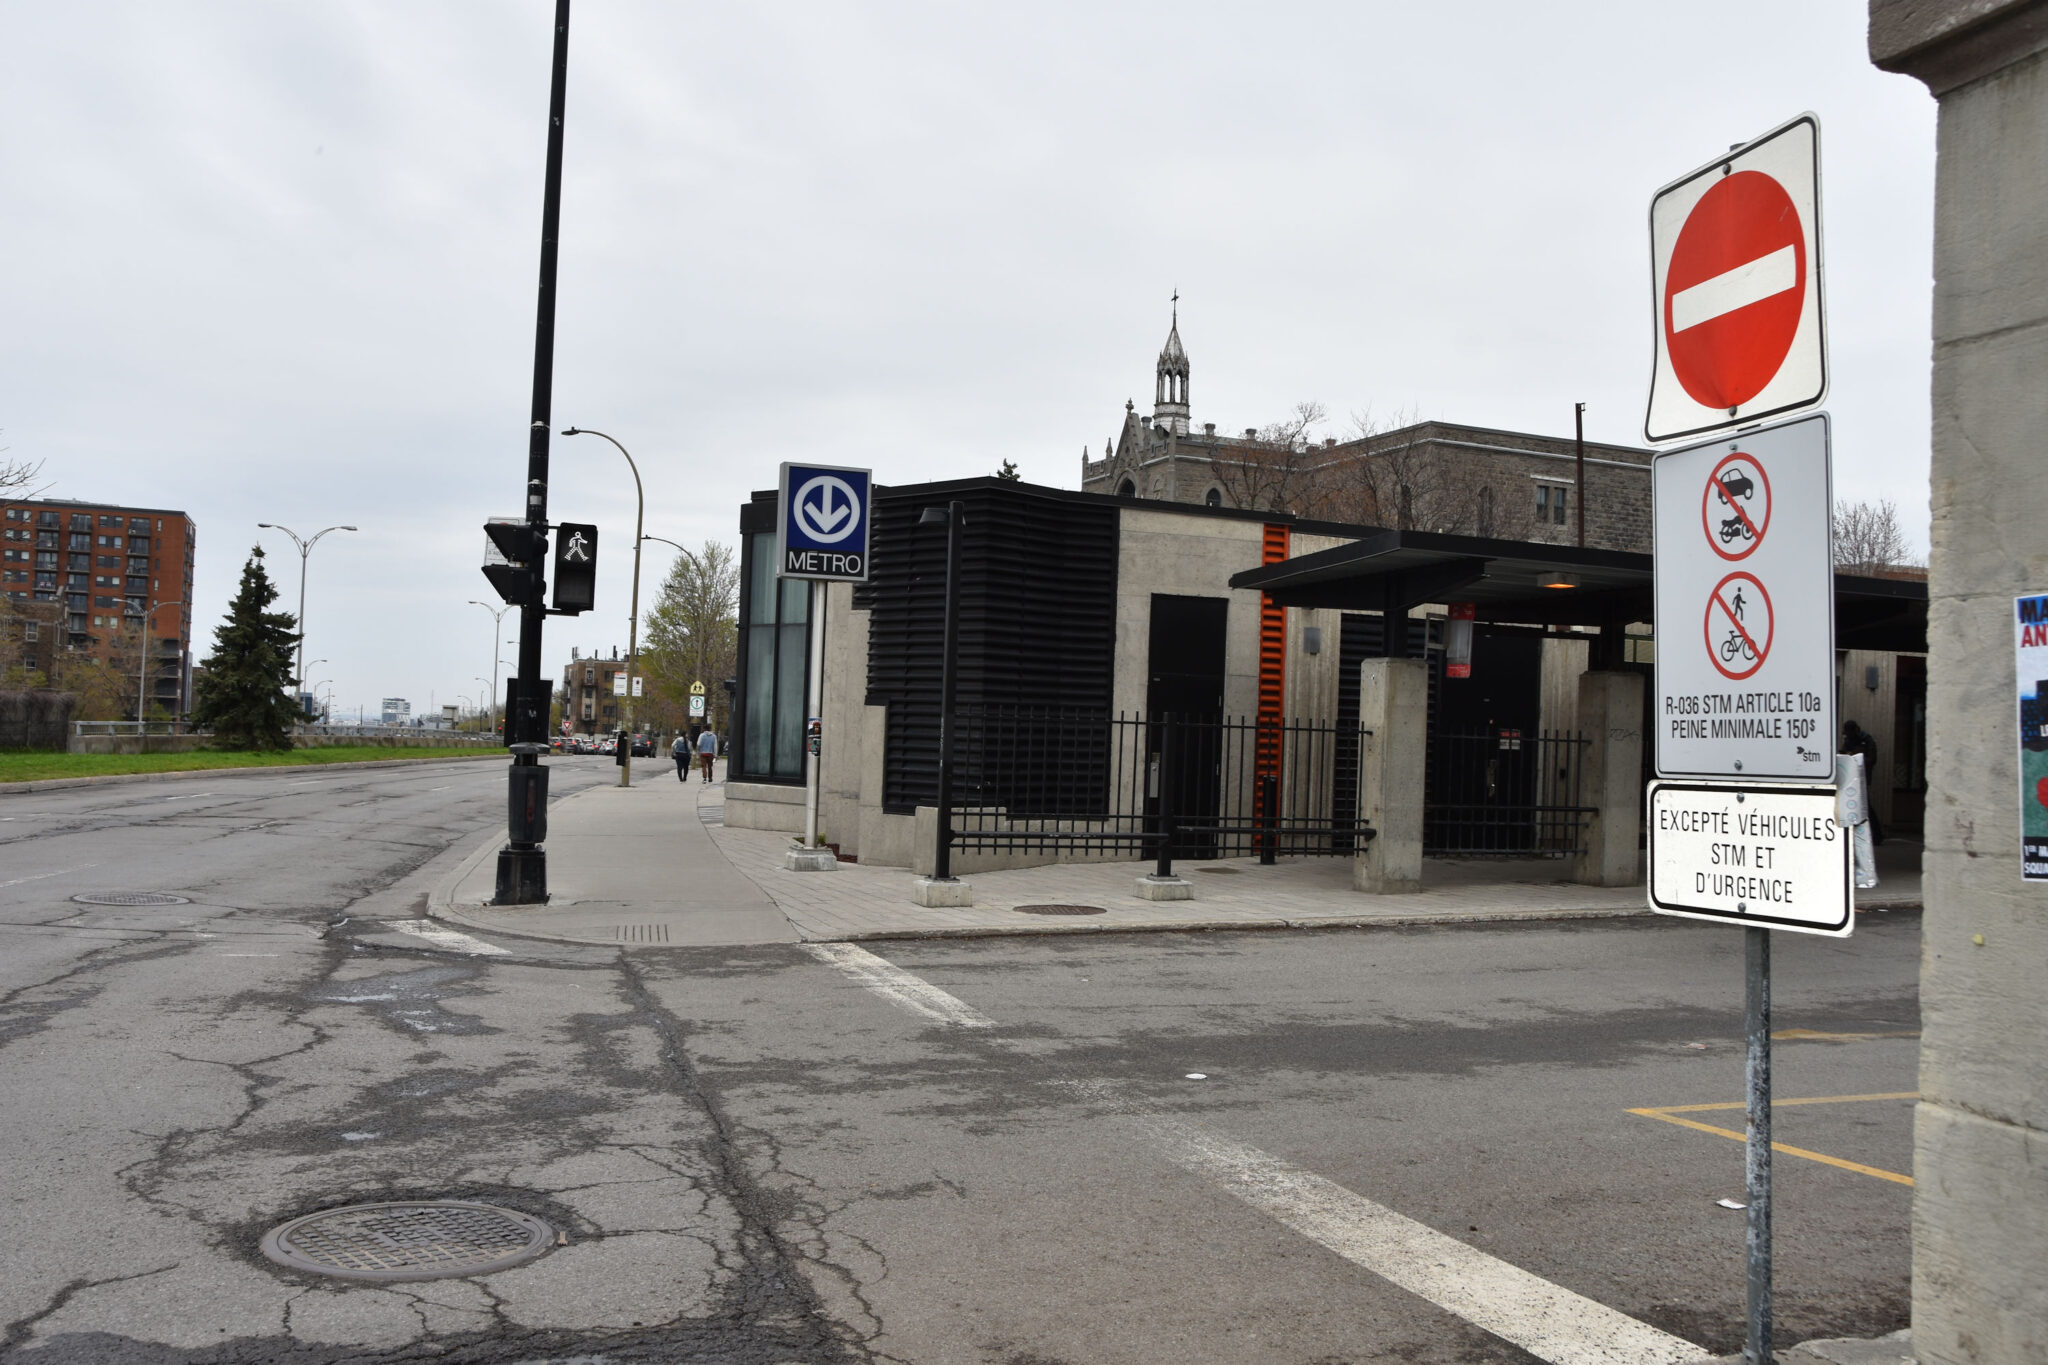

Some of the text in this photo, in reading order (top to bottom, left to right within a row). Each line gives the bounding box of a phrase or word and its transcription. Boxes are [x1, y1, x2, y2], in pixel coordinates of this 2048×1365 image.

[1666, 692, 1821, 714] R-036 STM ARTICLE 10a
[1672, 718, 1816, 738] PEINE MINIMALE 150$
[1802, 751, 1821, 762] stm
[1660, 806, 1835, 841] EXCEPTÉ VÉHICULES
[1711, 843, 1775, 869] STM ET
[1696, 872, 1793, 903] D'URGENCE
